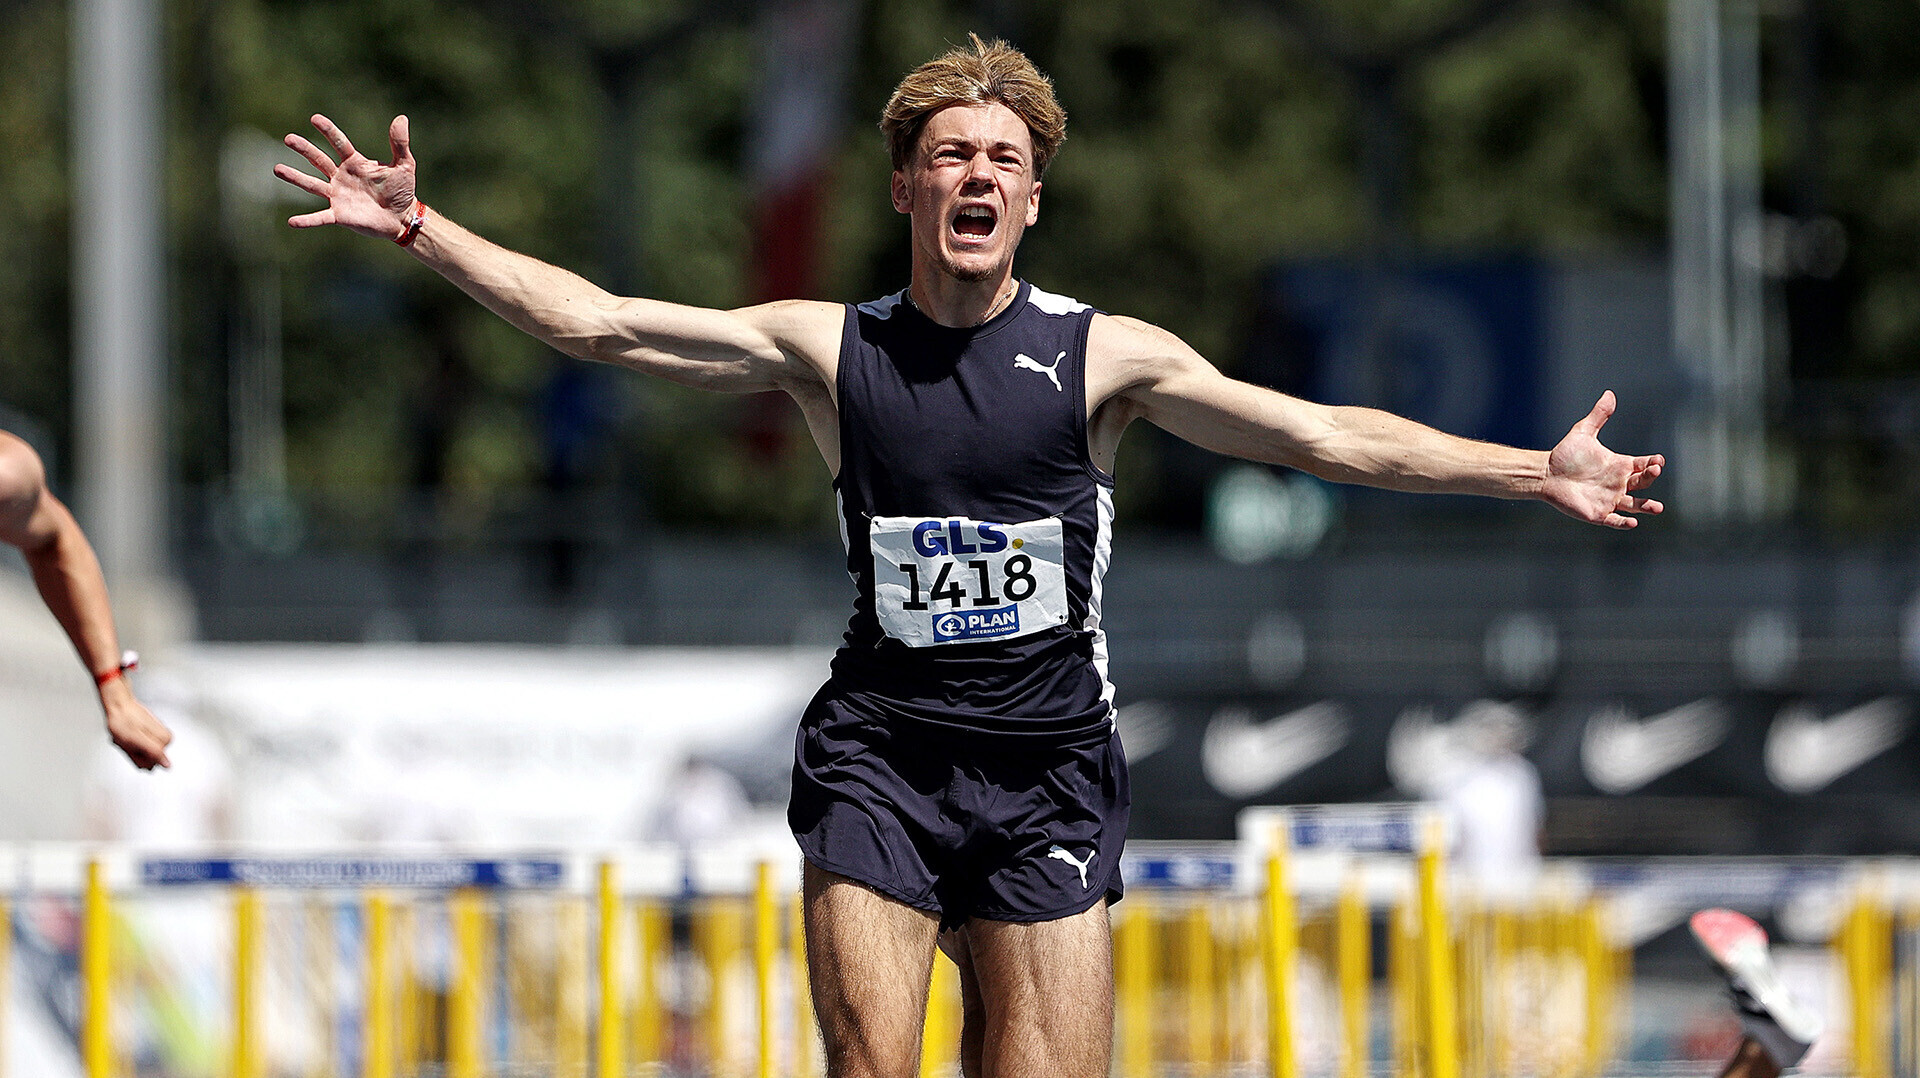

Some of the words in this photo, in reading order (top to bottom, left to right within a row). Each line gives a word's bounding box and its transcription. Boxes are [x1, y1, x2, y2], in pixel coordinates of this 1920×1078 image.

[900, 554, 1037, 611] 1418
[968, 610, 1016, 628] PLAN
[969, 624, 1017, 635] INTERNATIONAL
